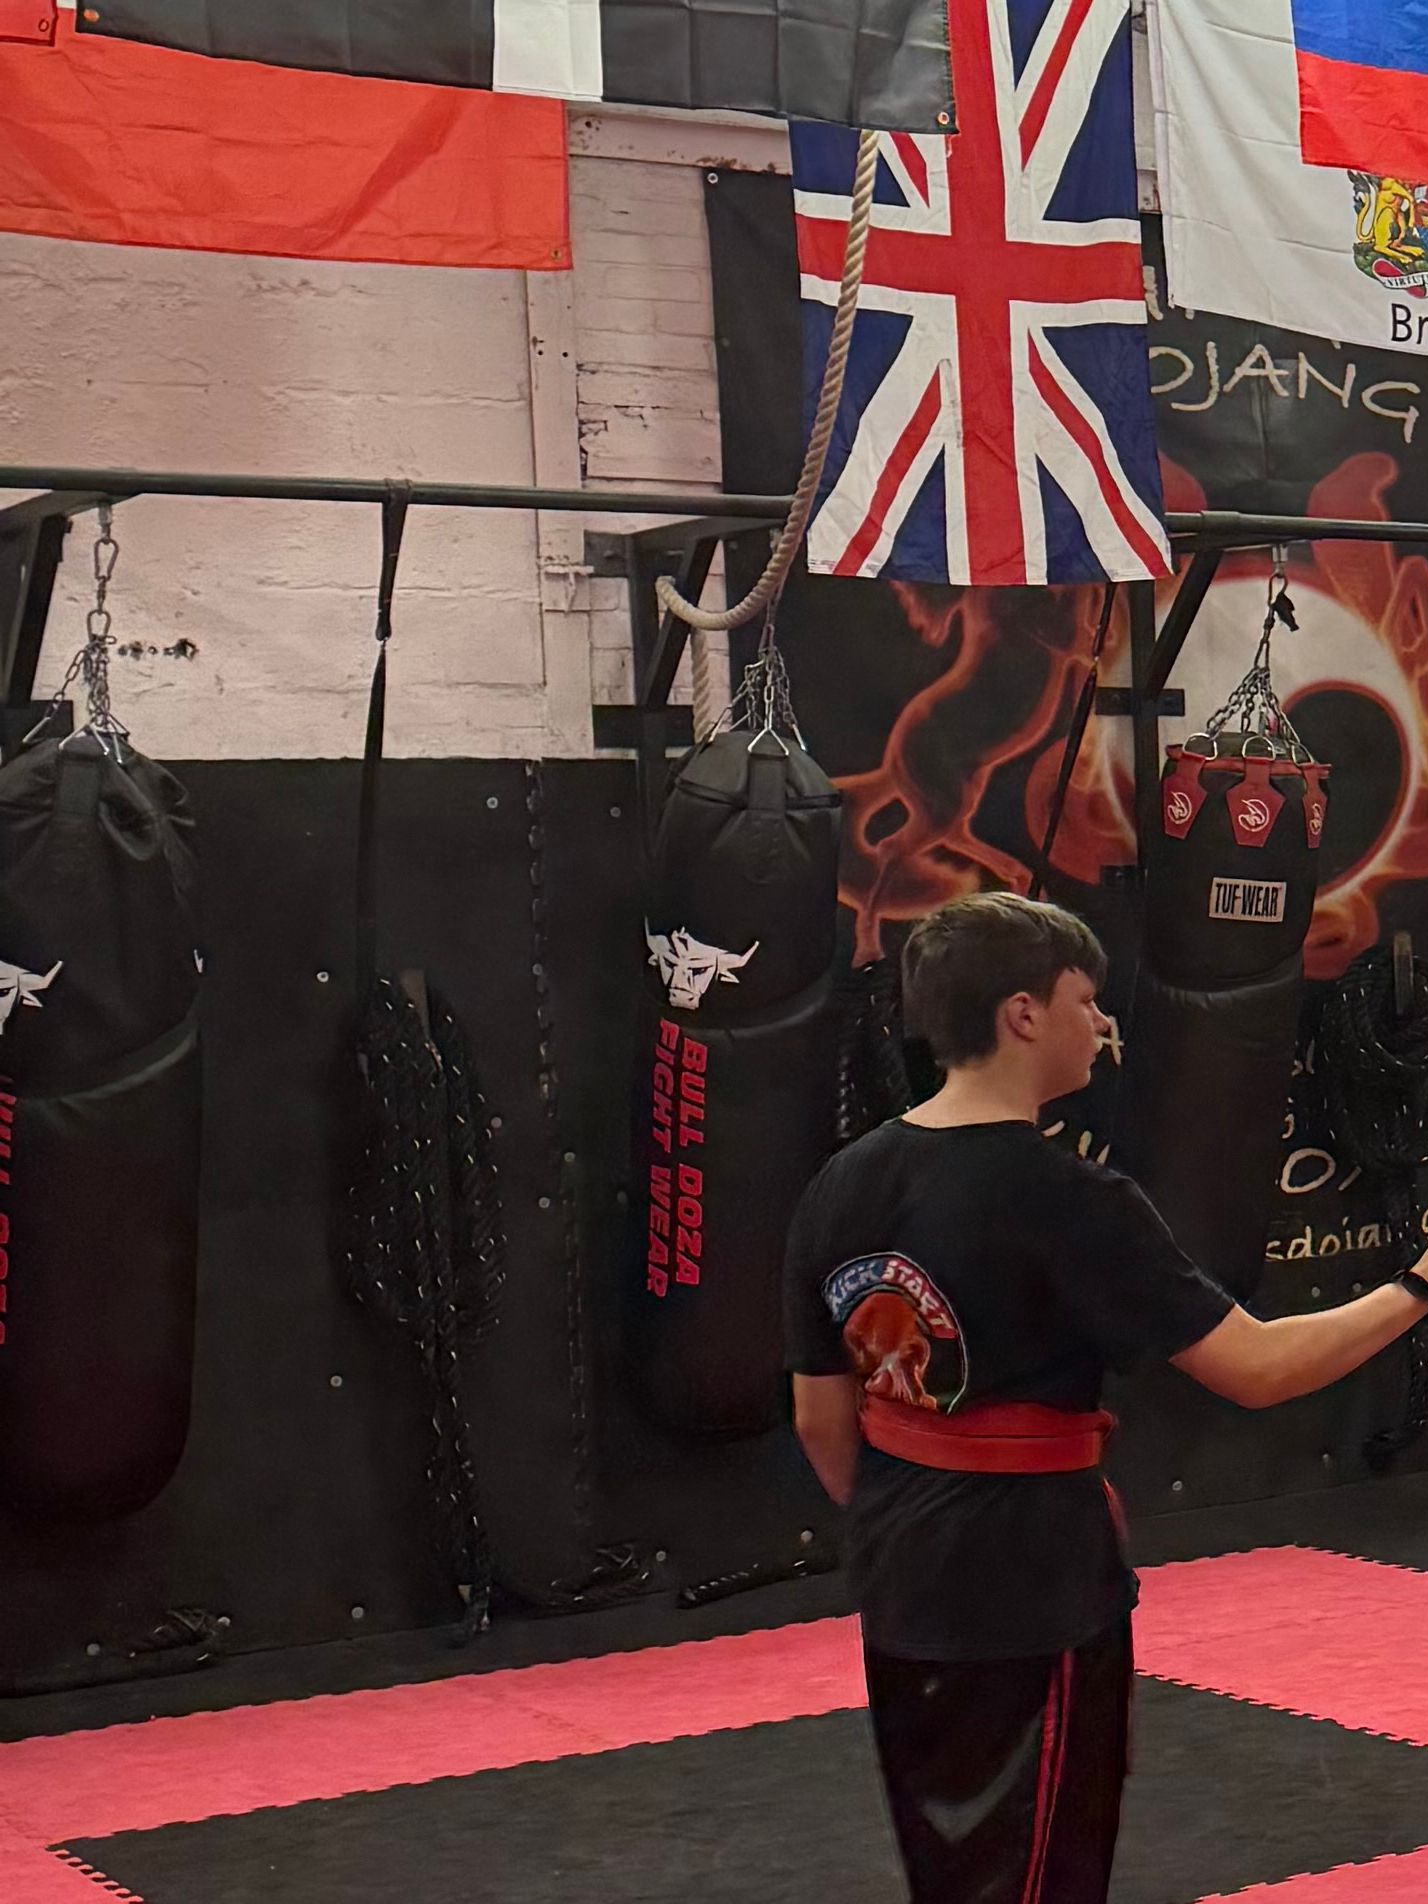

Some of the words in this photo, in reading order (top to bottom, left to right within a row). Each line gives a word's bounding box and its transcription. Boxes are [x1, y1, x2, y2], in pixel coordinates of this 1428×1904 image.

[1214, 882, 1280, 916] TUF-WEAR
[652, 1017, 680, 1154] FIGHT
[679, 1036, 708, 1147] BULL
[647, 1164, 671, 1298] WEAR
[676, 1162, 703, 1286] DOZA
